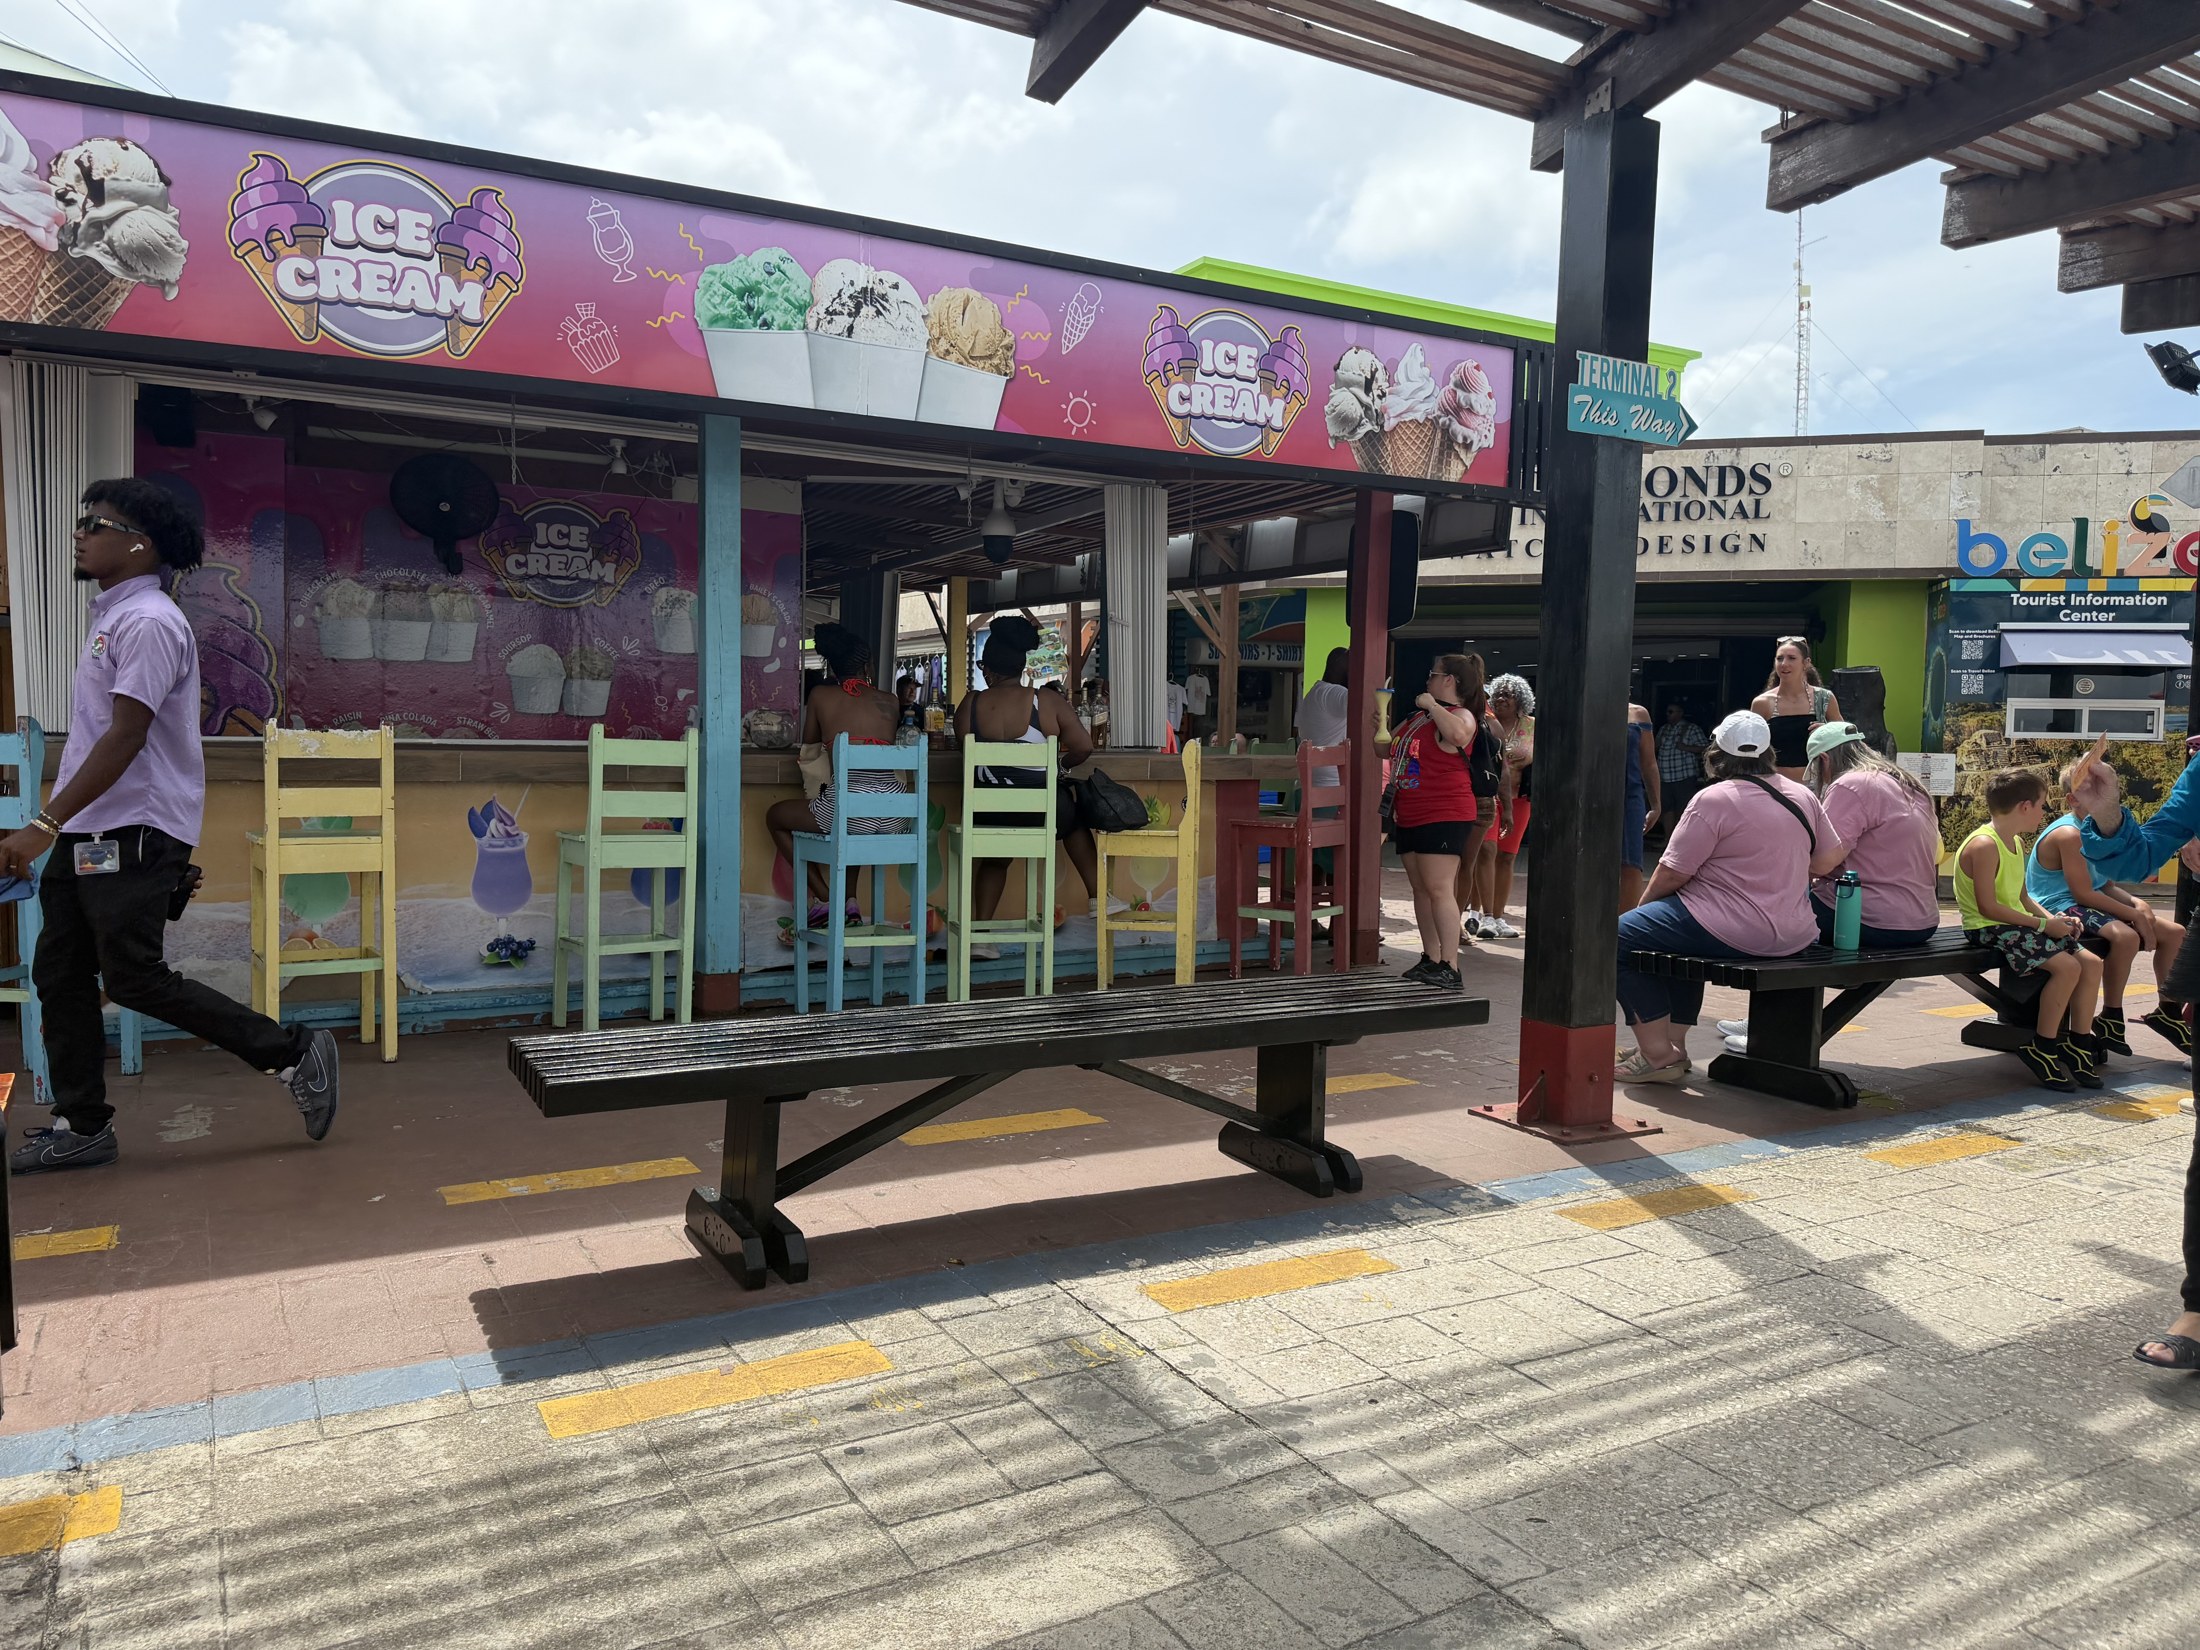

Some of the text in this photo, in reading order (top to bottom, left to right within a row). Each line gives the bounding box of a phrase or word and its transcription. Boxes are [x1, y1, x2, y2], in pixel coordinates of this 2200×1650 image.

[330, 199, 435, 259] ICE
[274, 256, 486, 324] CREAM
[1200, 339, 1258, 381] ICE
[1577, 352, 1677, 401] TERMINAL 2
[1167, 383, 1285, 429] CREAM
[1573, 394, 1678, 442] This Way
[1644, 462, 1772, 498] ONDS
[535, 522, 589, 550] ICE
[374, 567, 428, 582] CHOCOLATE
[504, 553, 616, 585] CREAM
[644, 576, 666, 594] OREO
[775, 599, 792, 625] COLADA
[2010, 592, 2168, 606] Tourist Information
[2058, 609, 2116, 622] Center
[498, 633, 533, 660] SOURSOP
[593, 636, 621, 661] COFFEE
[332, 711, 362, 726] RAISIN
[402, 712, 438, 728] COLADA
